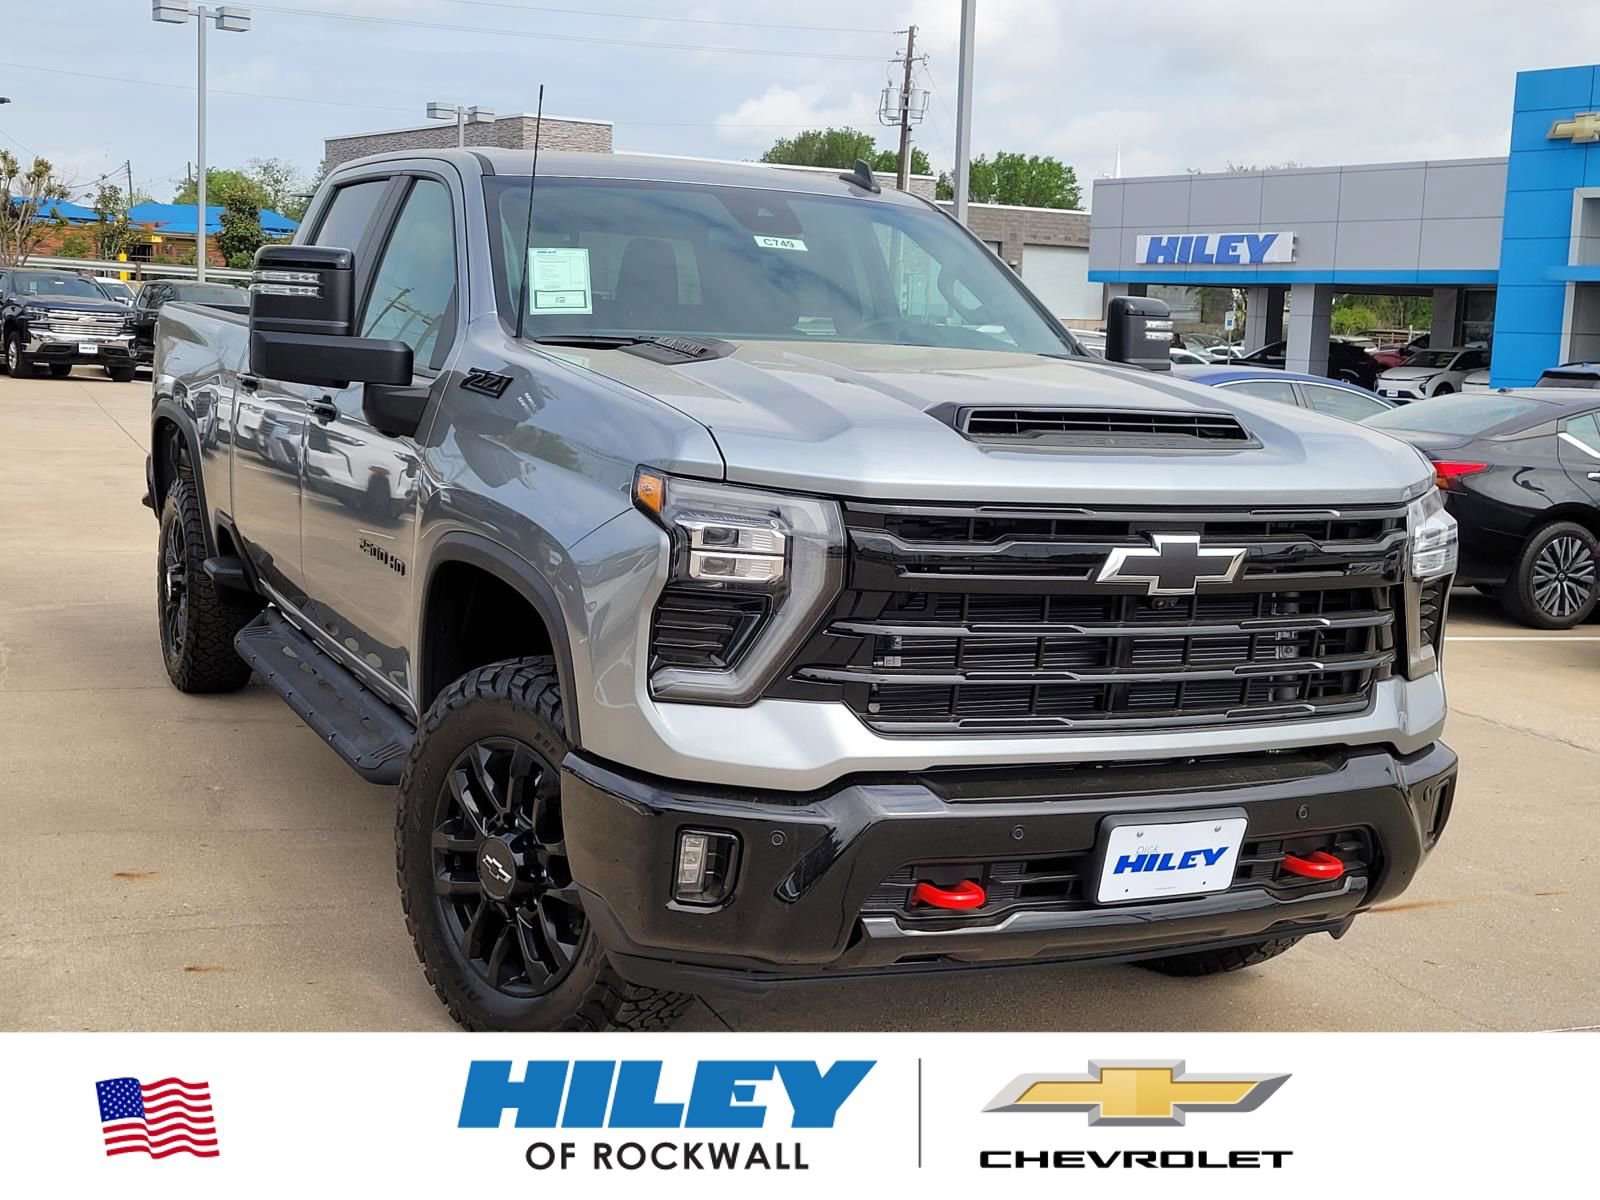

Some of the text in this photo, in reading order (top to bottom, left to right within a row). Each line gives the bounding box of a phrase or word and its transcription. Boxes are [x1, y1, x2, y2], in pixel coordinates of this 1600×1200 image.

[763, 238, 795, 248] C749
[1146, 234, 1279, 264] HILEY
[1113, 846, 1230, 875] HILEY
